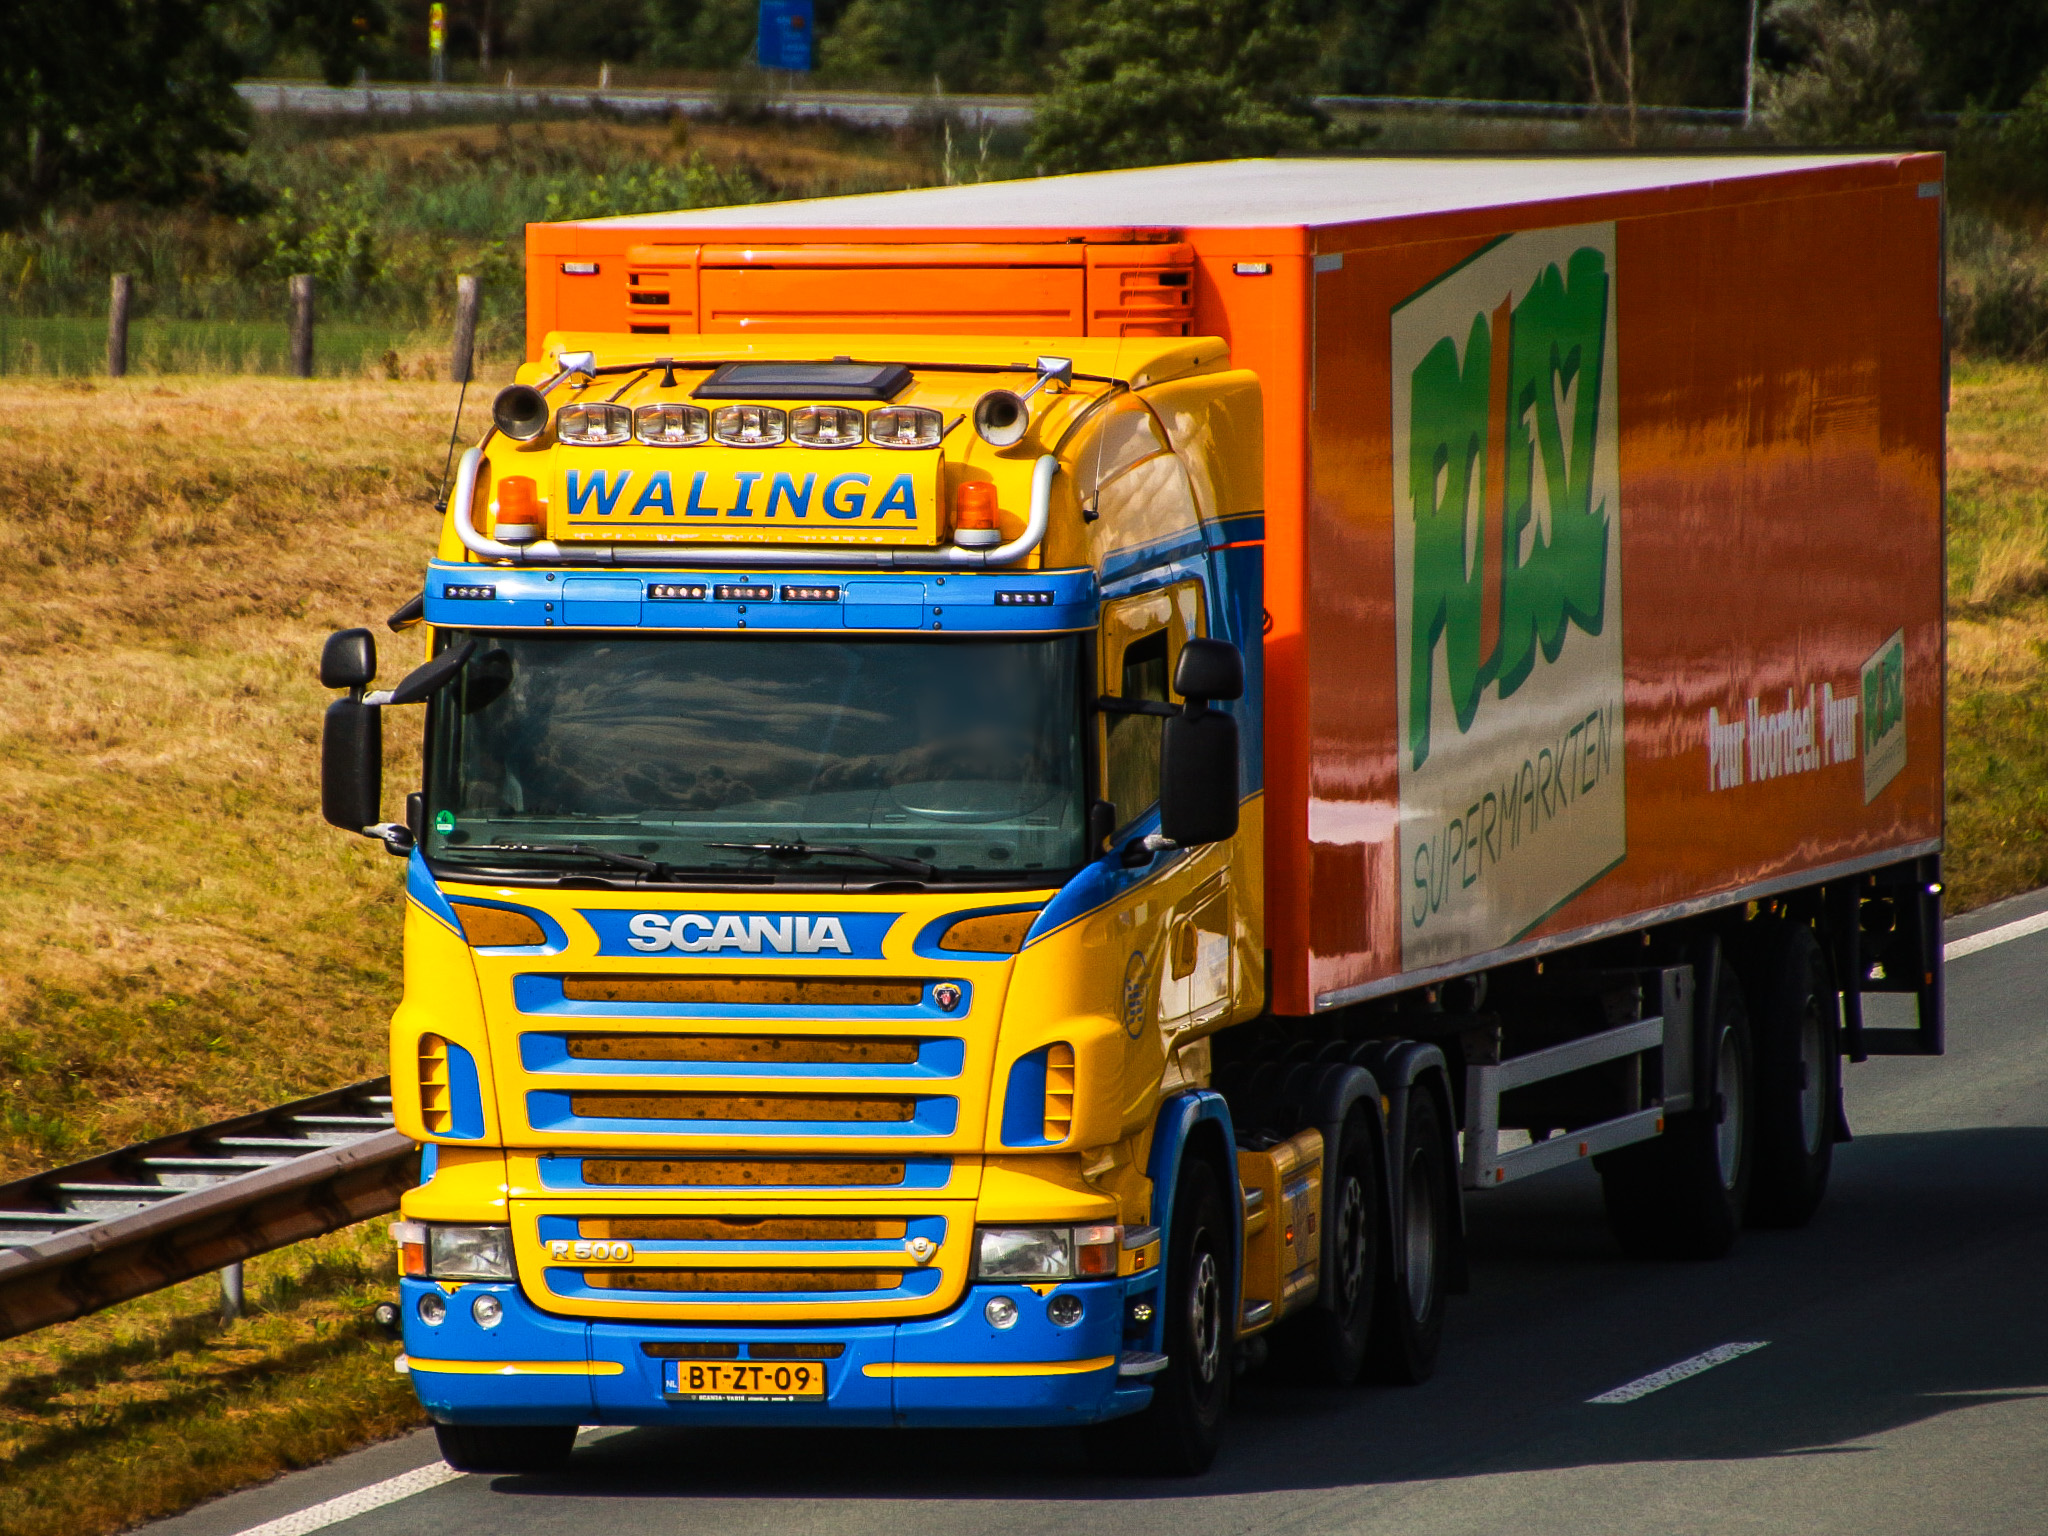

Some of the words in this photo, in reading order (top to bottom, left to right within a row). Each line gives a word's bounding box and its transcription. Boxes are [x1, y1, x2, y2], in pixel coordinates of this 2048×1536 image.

[565, 469, 918, 520] WALINGA
[1410, 246, 1611, 772] POIESZ
[1709, 706, 1746, 792] Puur
[1823, 682, 1859, 767] Puur
[1412, 698, 1613, 928] SUPERMARKTEN
[627, 913, 853, 953] SCANIA
[551, 1241, 569, 1260] R
[574, 1242, 629, 1261] 500
[665, 1380, 678, 1389] NL
[689, 1366, 811, 1391] BT-ZT-09
